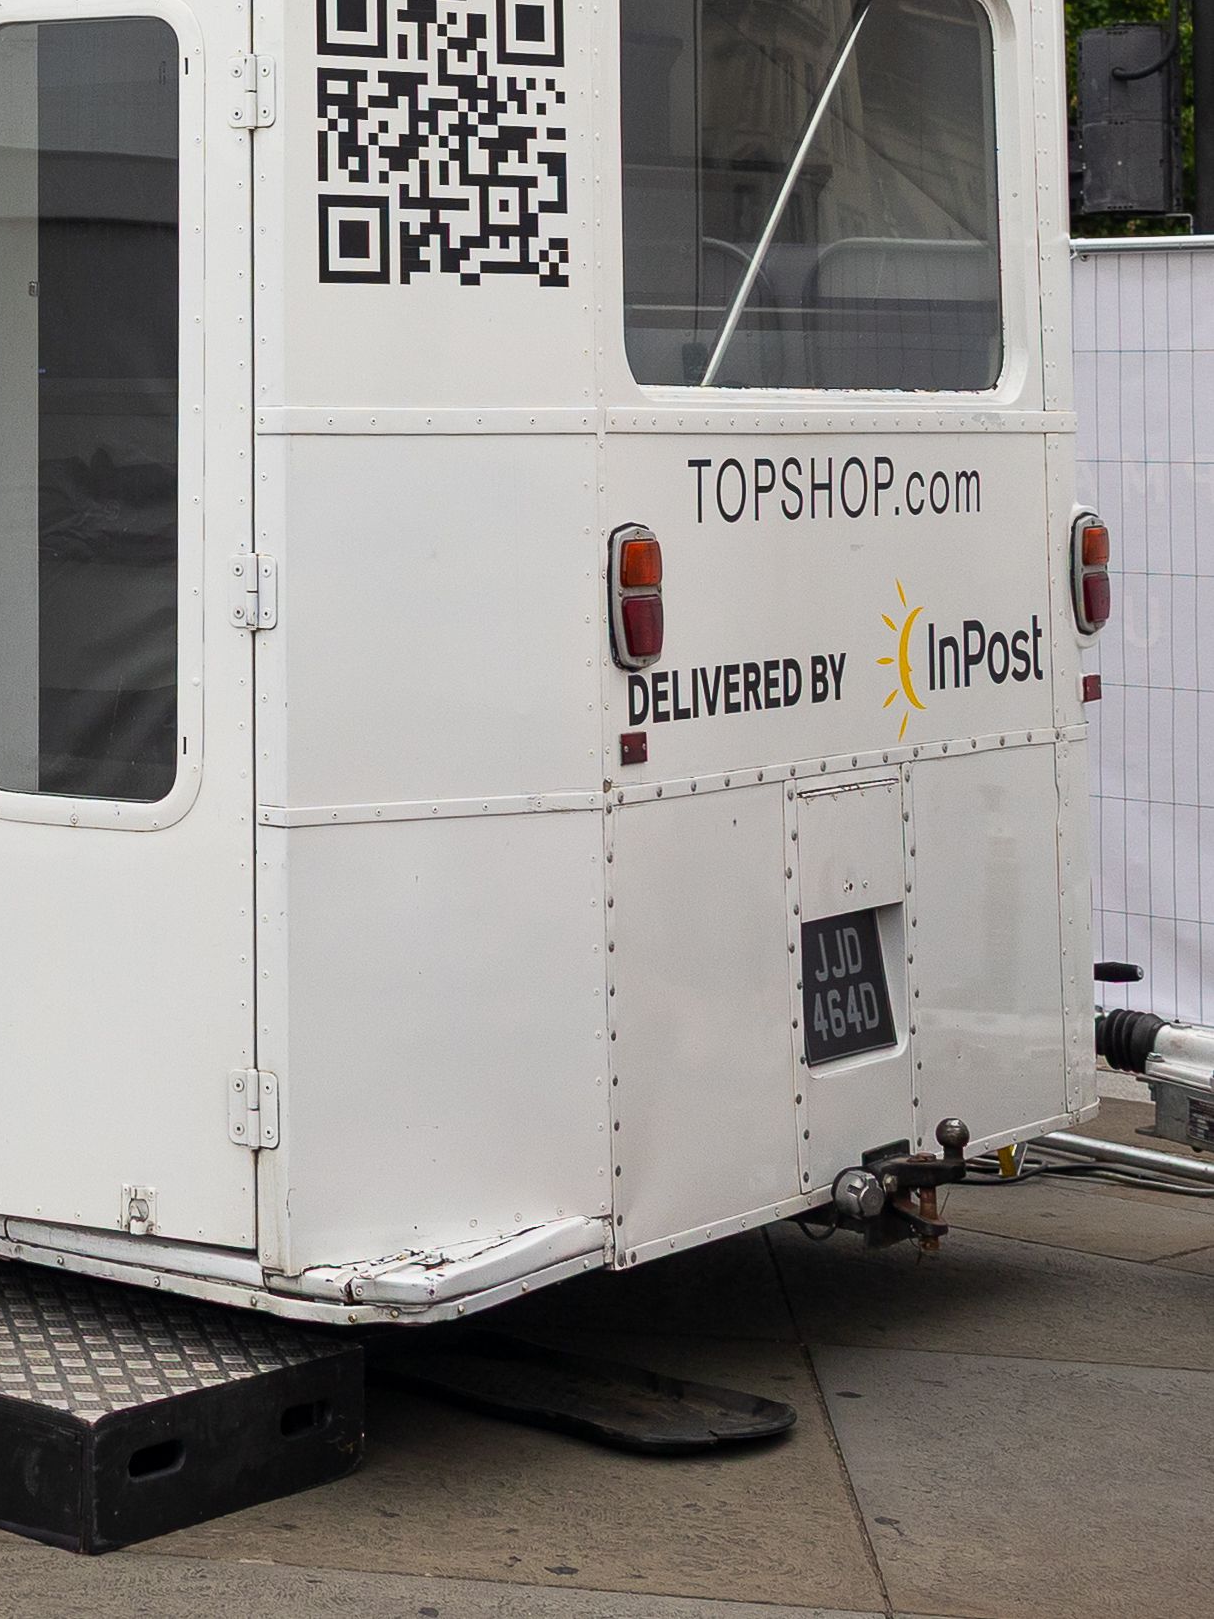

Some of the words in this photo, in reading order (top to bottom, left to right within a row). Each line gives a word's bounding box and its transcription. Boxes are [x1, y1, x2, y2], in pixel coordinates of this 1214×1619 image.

[687, 456, 981, 524] TOPSHOP.com
[627, 658, 803, 727] DELIVERED
[810, 652, 847, 704] BY
[928, 614, 1044, 691] InPost
[815, 927, 862, 982] JJD
[813, 982, 879, 1041] 464D
